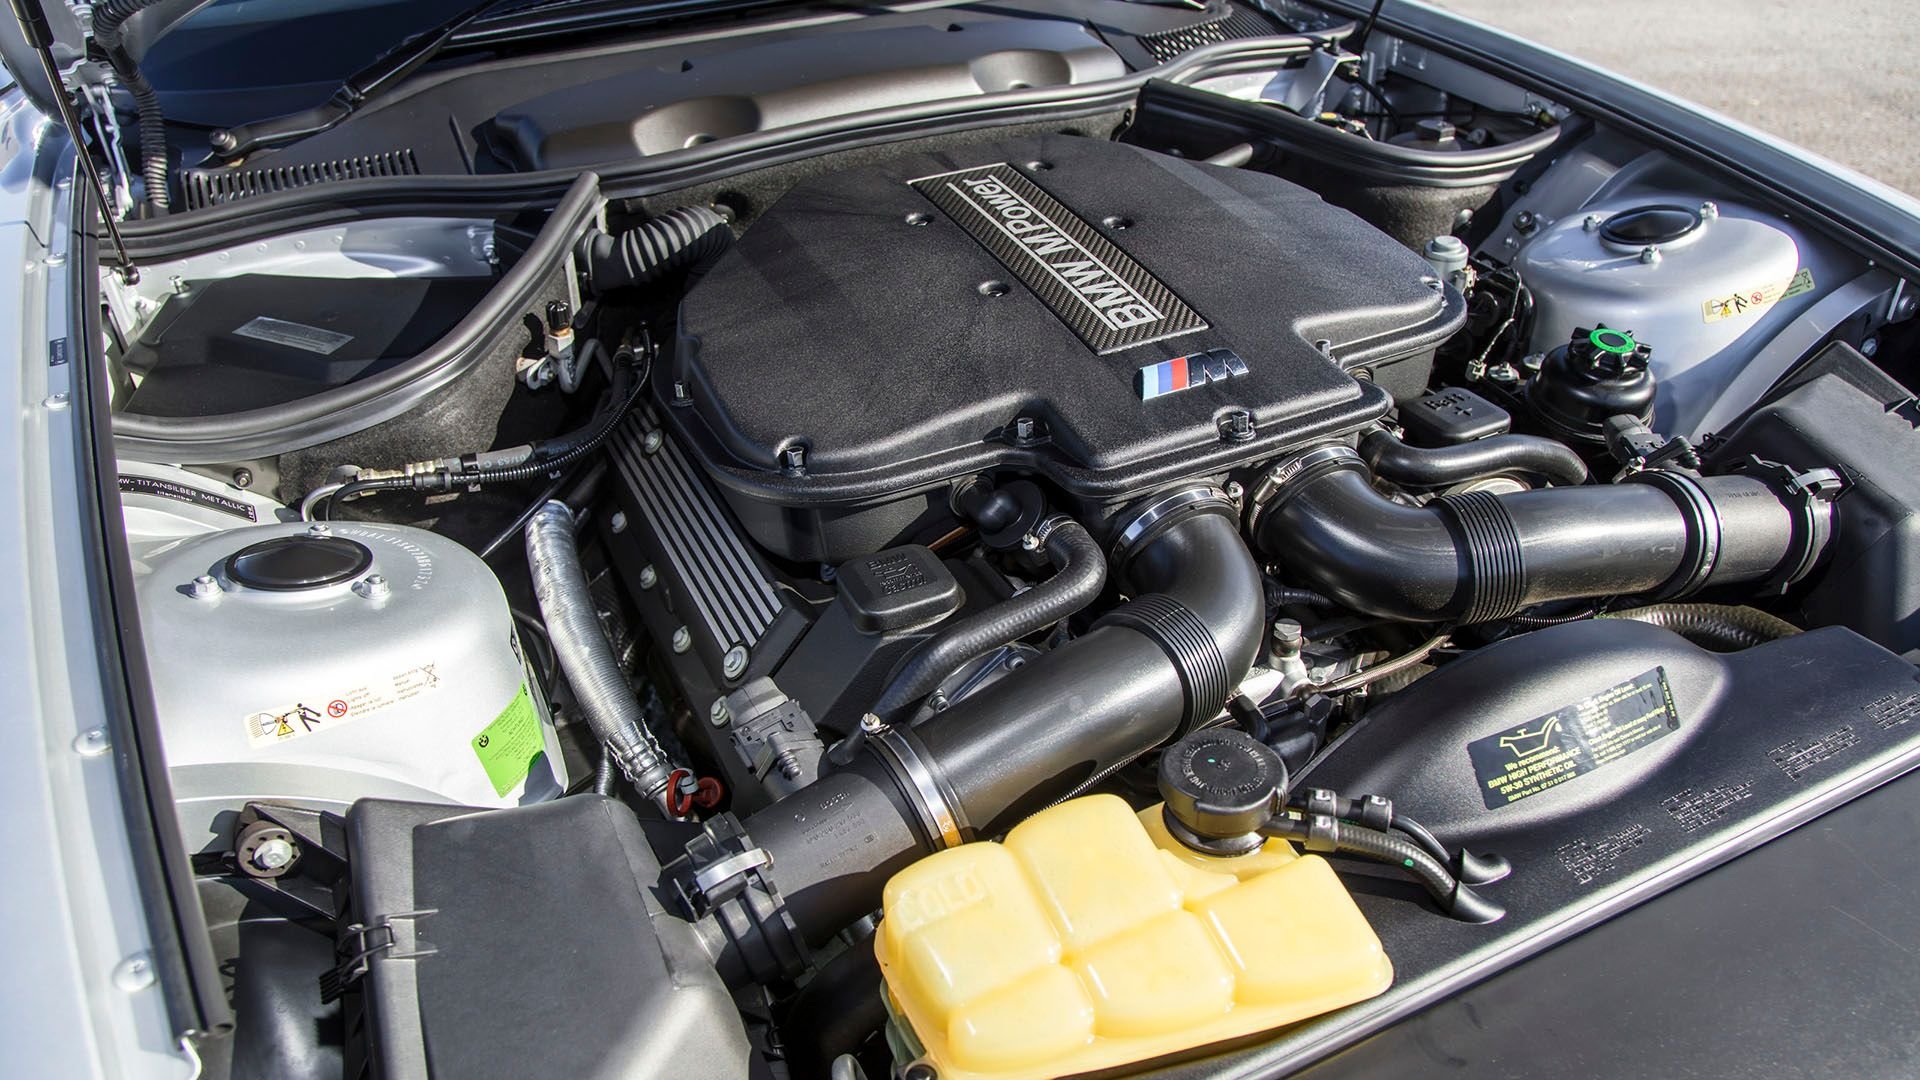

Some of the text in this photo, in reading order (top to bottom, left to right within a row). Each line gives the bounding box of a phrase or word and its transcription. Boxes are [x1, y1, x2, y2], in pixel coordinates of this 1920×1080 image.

[1051, 260, 1157, 330] BMW
[201, 493, 246, 513] METALLIC
[1487, 775, 1508, 788] BMW
[1508, 767, 1527, 780] HIGH
[1527, 745, 1583, 773] PERFORMANCE
[1499, 759, 1576, 794] 5W-30 SYNTHETIC OIL
[1504, 761, 1518, 771] We
[896, 864, 987, 931] COLD
